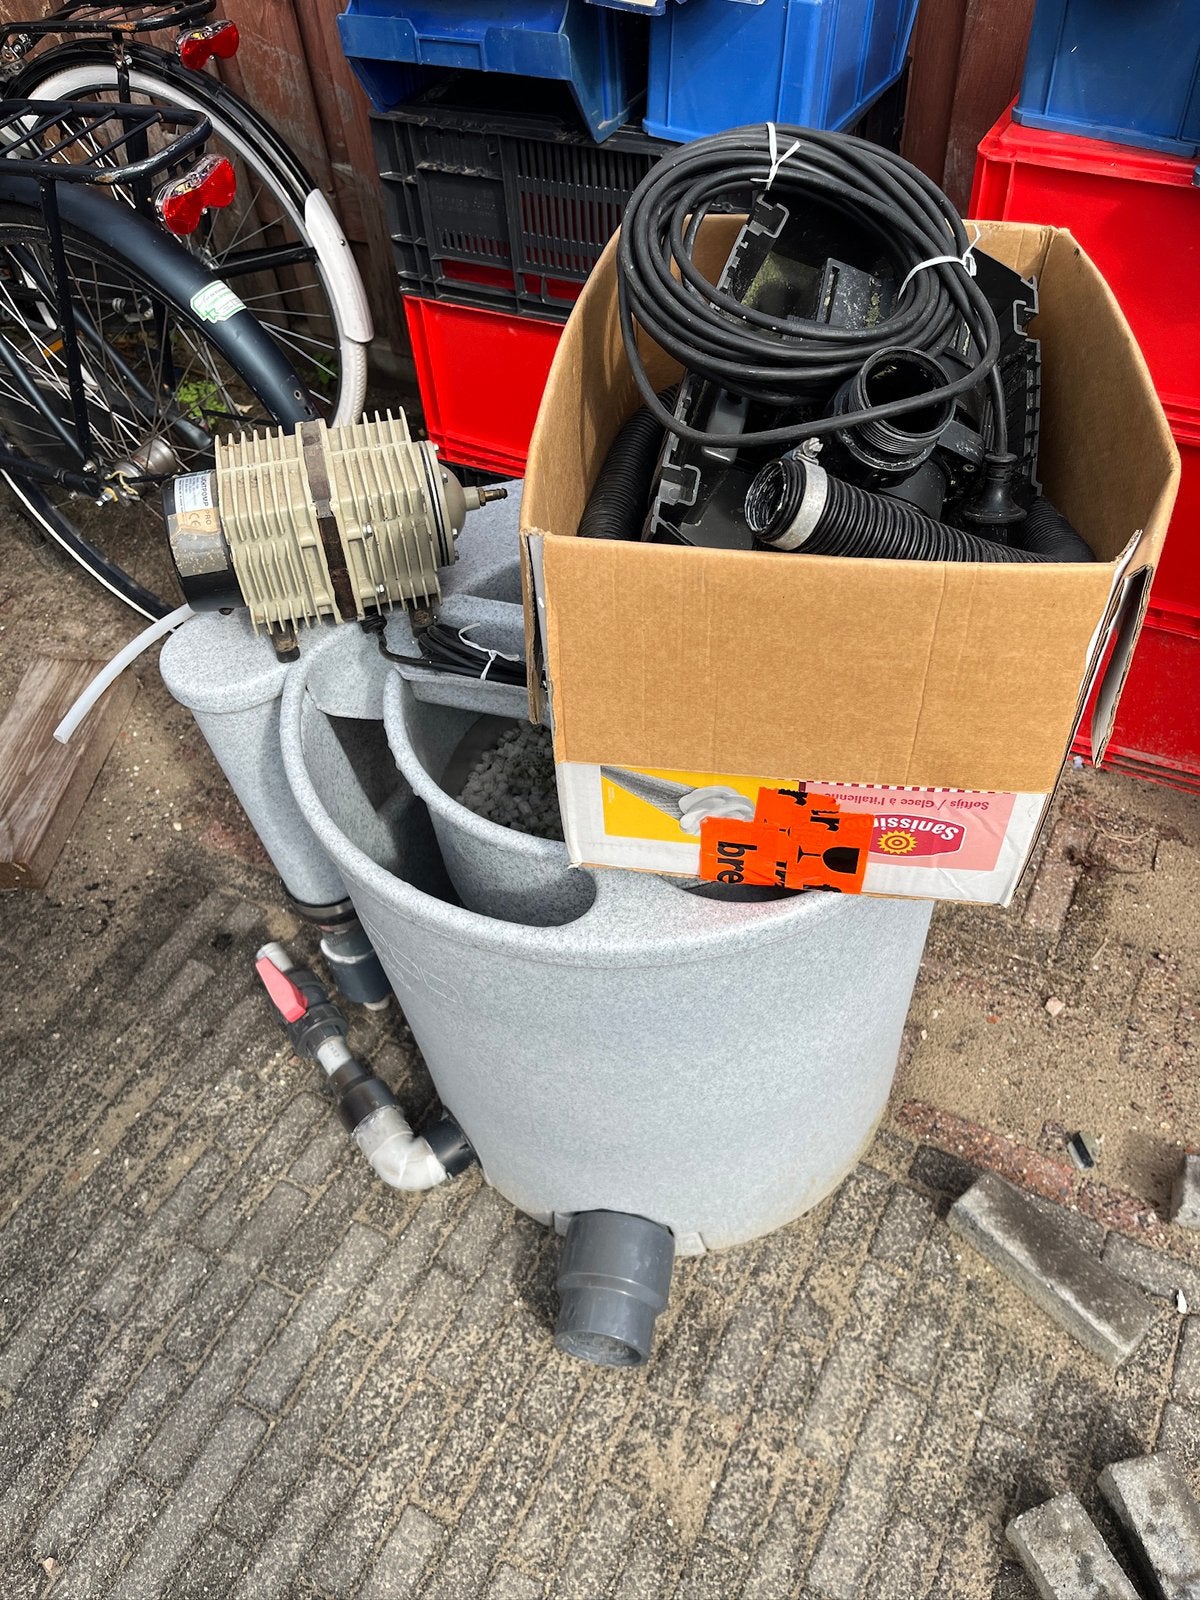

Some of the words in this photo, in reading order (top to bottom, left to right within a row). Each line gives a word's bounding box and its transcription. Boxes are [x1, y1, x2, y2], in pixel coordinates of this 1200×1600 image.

[889, 797, 897, 806] à
[900, 797, 934, 809] Glace
[950, 800, 990, 811] Softijs
[873, 817, 960, 841] Sanissi
